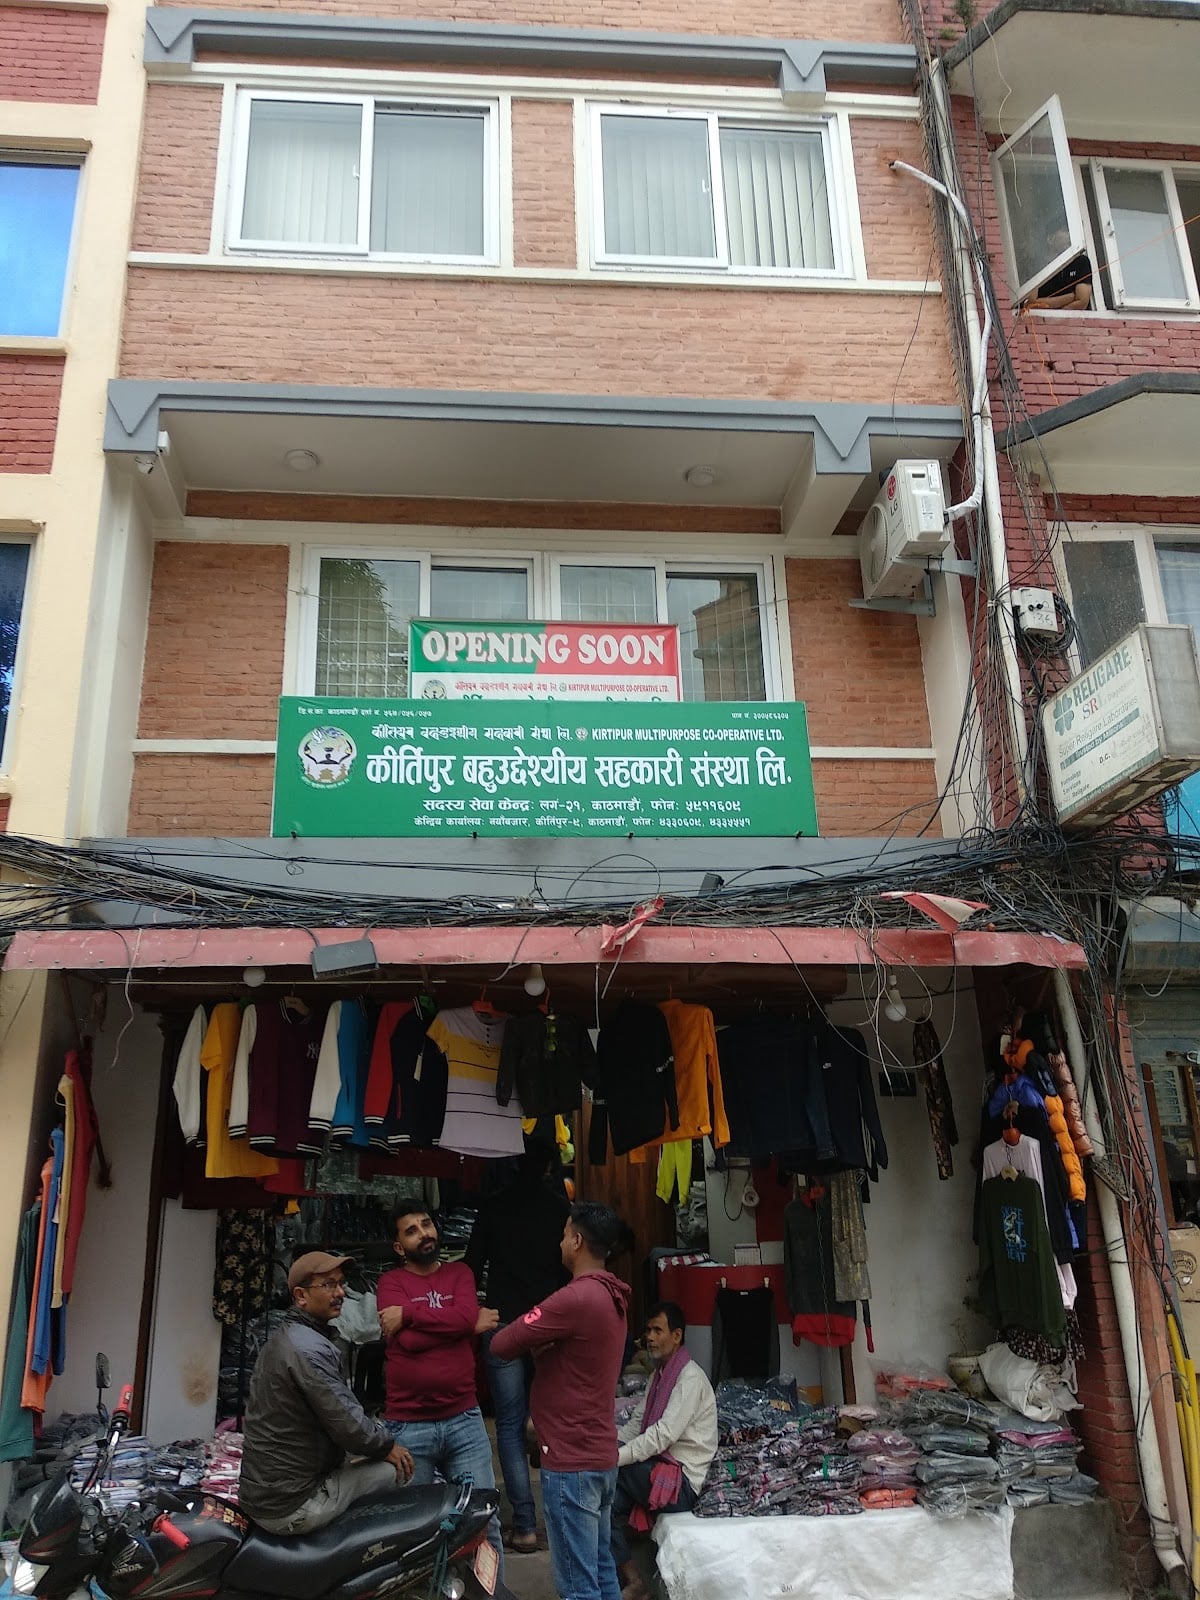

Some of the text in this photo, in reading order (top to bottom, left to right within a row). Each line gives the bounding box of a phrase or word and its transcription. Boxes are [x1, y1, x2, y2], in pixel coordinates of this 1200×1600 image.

[890, 500, 899, 516] LG
[422, 630, 665, 666] OPENING SOON
[1073, 644, 1132, 706] RELIGARE
[567, 683, 590, 692] KIRTIPUR
[590, 683, 625, 693] MULTIPURPOSE
[625, 684, 658, 694] CO-OPERATIVE
[592, 728, 785, 742] KIRTIPUR MULTIPURPOSE CO-OPERATIVE LTD.
[366, 745, 792, 794] कीर्तिपुर बहुउद्देश्यीय सहकारी संस्था लि.
[422, 798, 466, 812] सदस्य
[469, 796, 495, 812] सेवा
